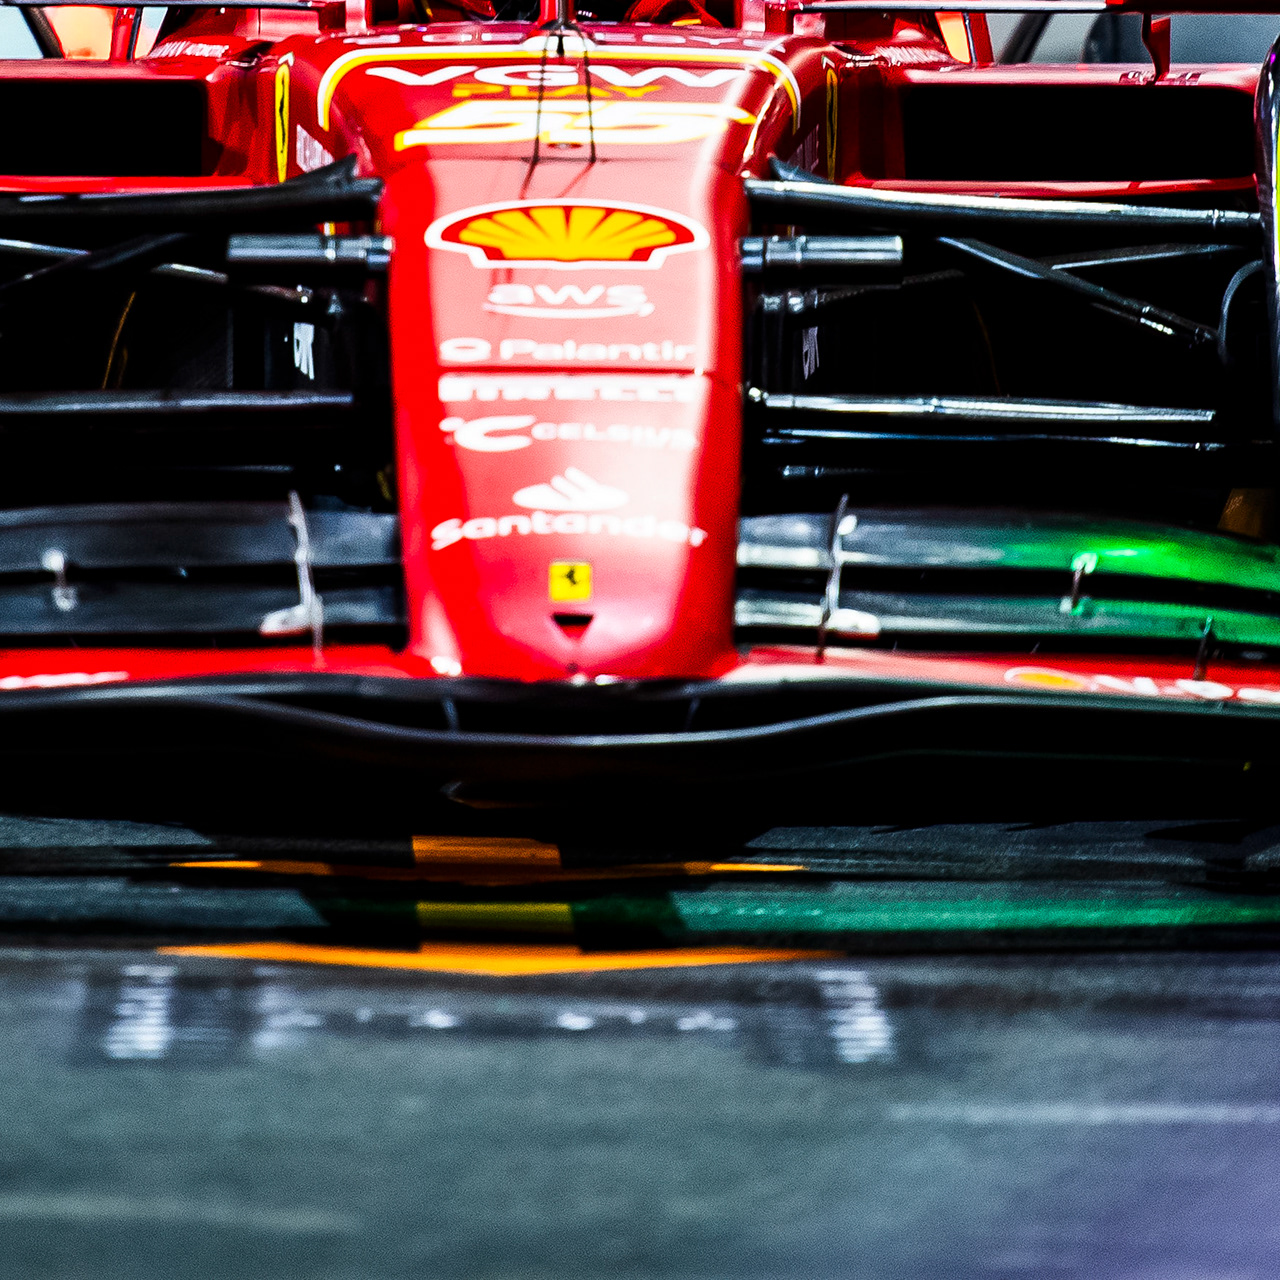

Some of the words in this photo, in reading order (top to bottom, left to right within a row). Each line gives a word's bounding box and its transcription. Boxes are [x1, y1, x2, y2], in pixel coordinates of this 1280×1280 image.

[364, 64, 750, 89] VGW
[451, 82, 662, 99] PLAY
[486, 282, 650, 306] aws
[499, 337, 696, 362] Palantir
[430, 510, 710, 551] Santander
